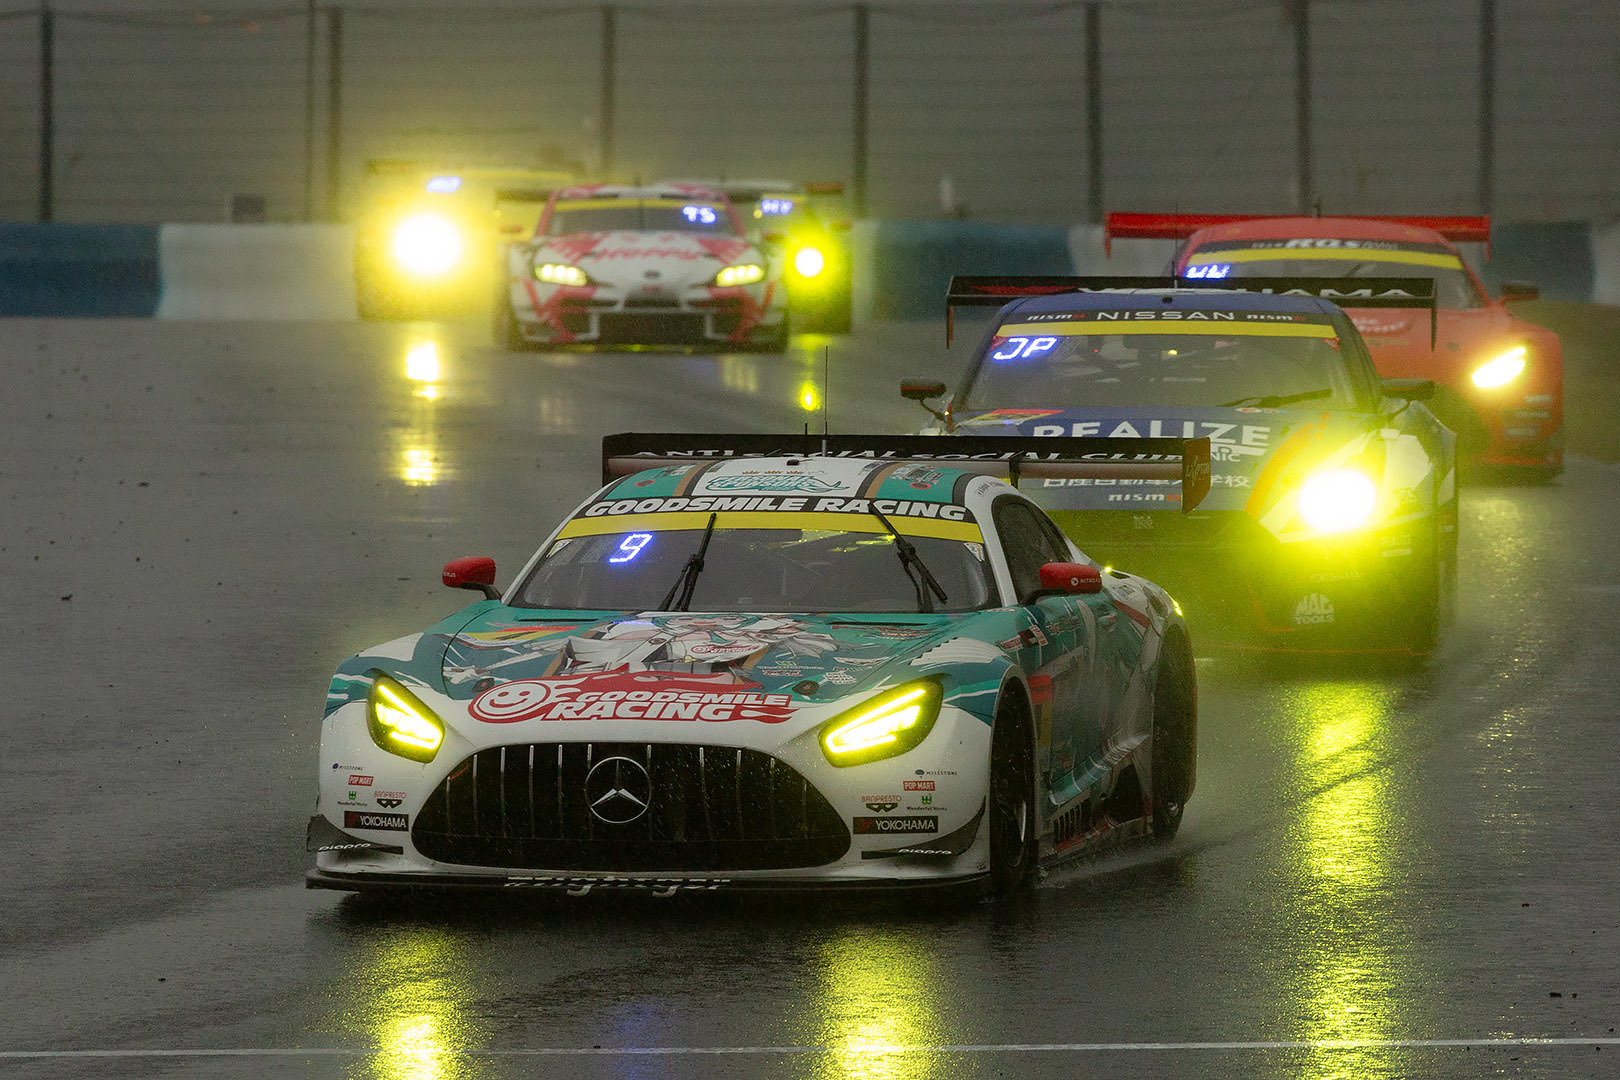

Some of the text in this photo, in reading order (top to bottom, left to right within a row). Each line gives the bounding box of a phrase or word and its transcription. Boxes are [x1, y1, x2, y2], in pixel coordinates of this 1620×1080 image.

[1027, 313, 1085, 321] nismo
[1096, 310, 1235, 321] NISSAN
[992, 336, 1058, 361] JP
[1108, 493, 1181, 502] nismo
[584, 497, 967, 521] GOODSMILE RACING
[609, 532, 654, 564] 9
[579, 691, 790, 707] GOODSMILE
[546, 701, 735, 721] RACING
[349, 776, 373, 786] POP MART
[904, 781, 935, 790] POP MART
[374, 790, 407, 799] BANPRESTO
[861, 795, 902, 803] BANPRESTO
[360, 815, 407, 828] YOKOHAMA
[875, 819, 935, 831] YOKOHAMA
